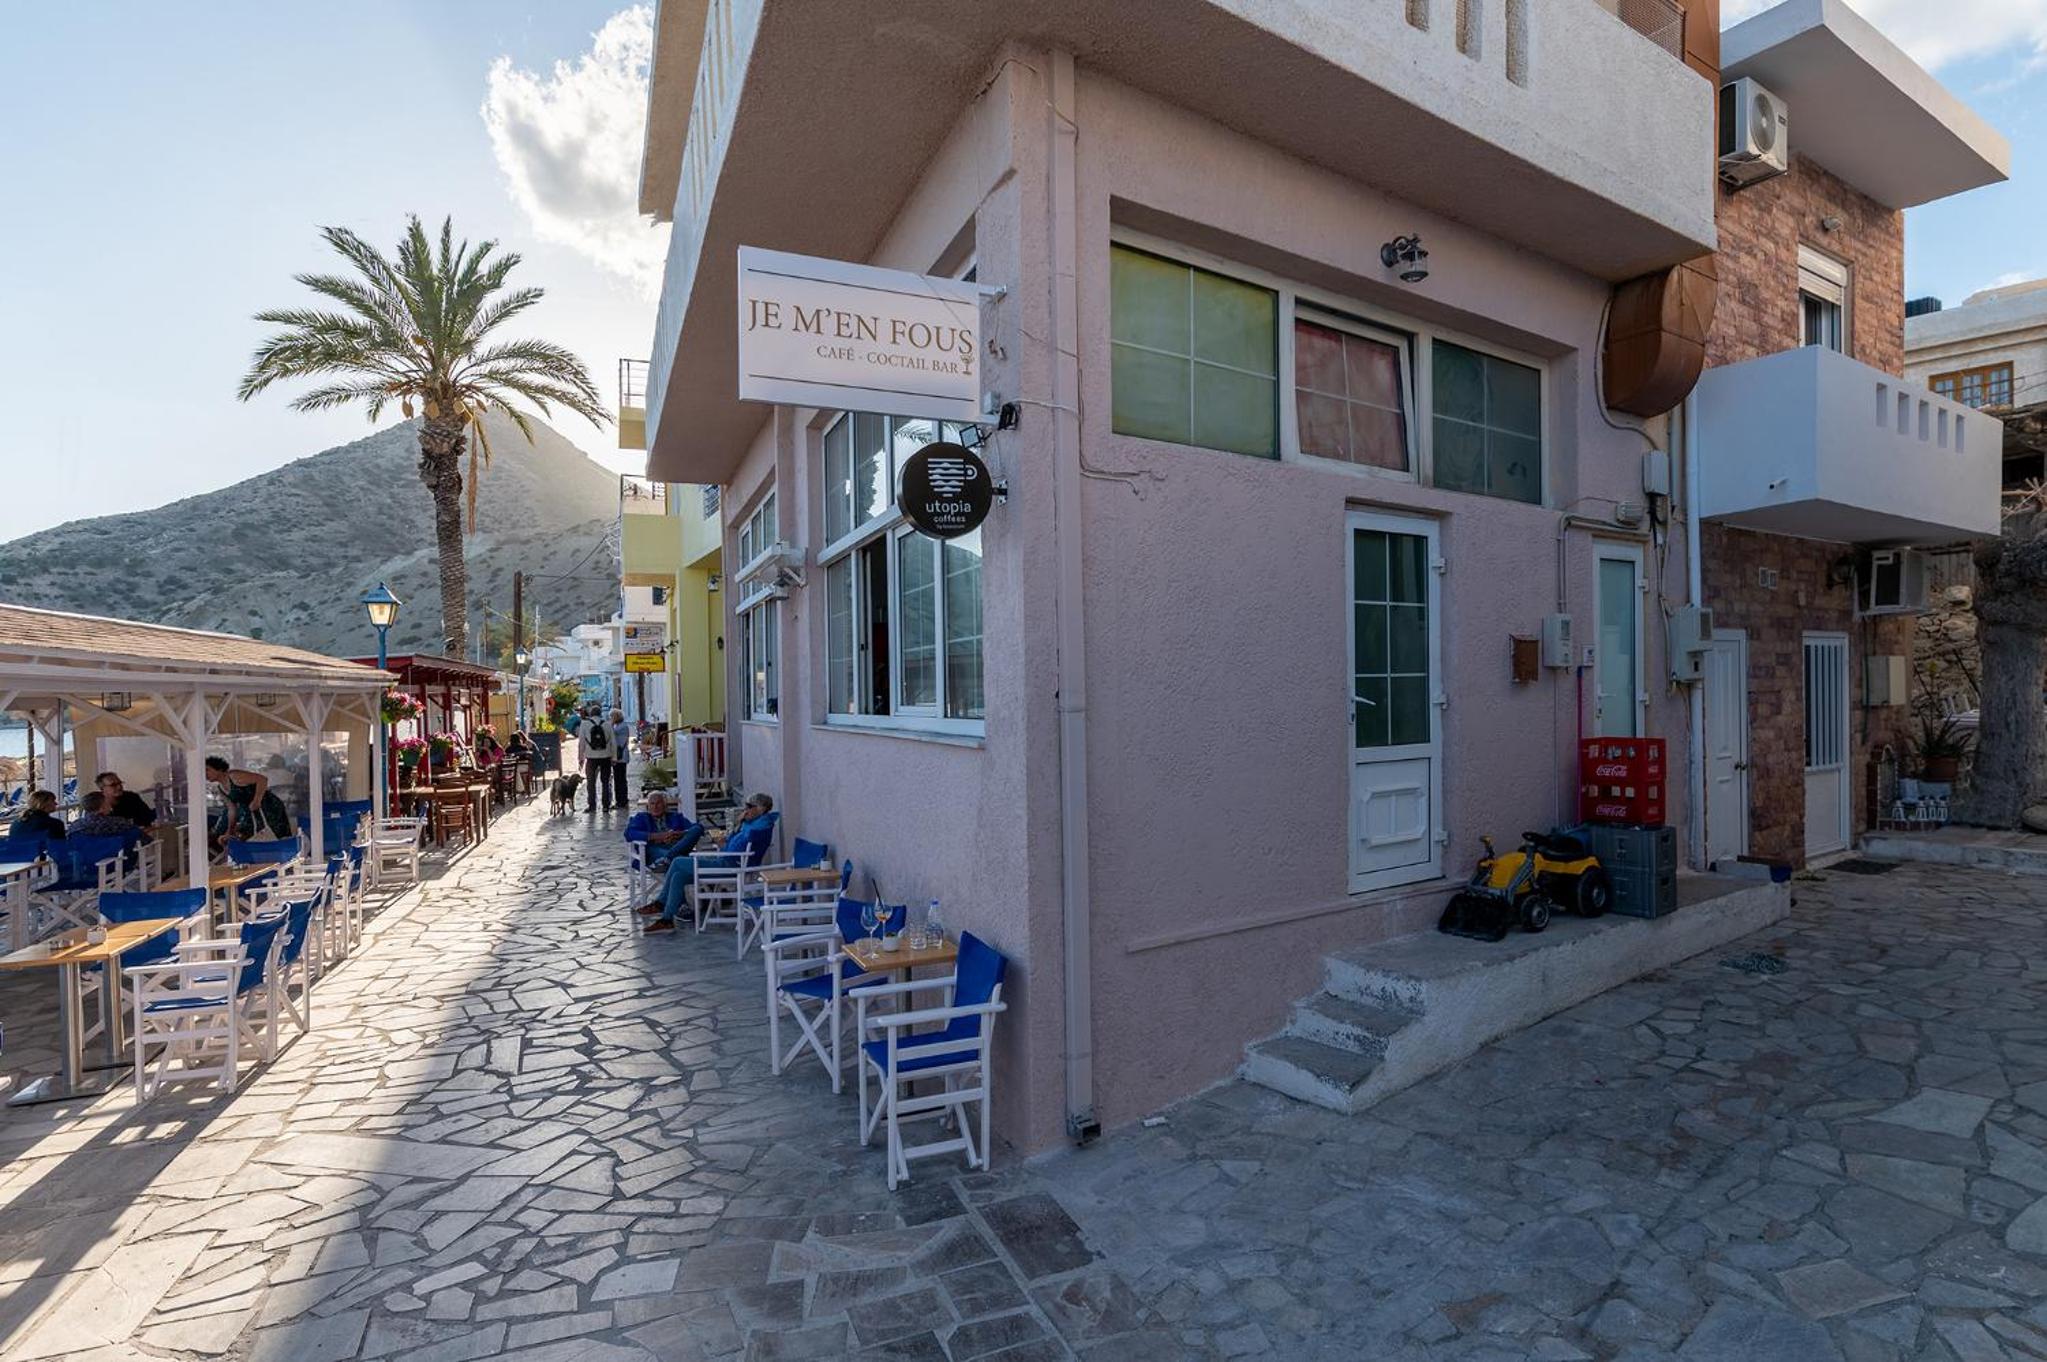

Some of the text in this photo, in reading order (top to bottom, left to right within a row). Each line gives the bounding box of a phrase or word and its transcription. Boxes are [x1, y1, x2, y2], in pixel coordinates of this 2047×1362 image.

[748, 298, 973, 355] JE M'EN FOUS
[867, 351, 928, 371] COCTAIL
[932, 359, 959, 374] BAR
[926, 500, 971, 515] utopia
